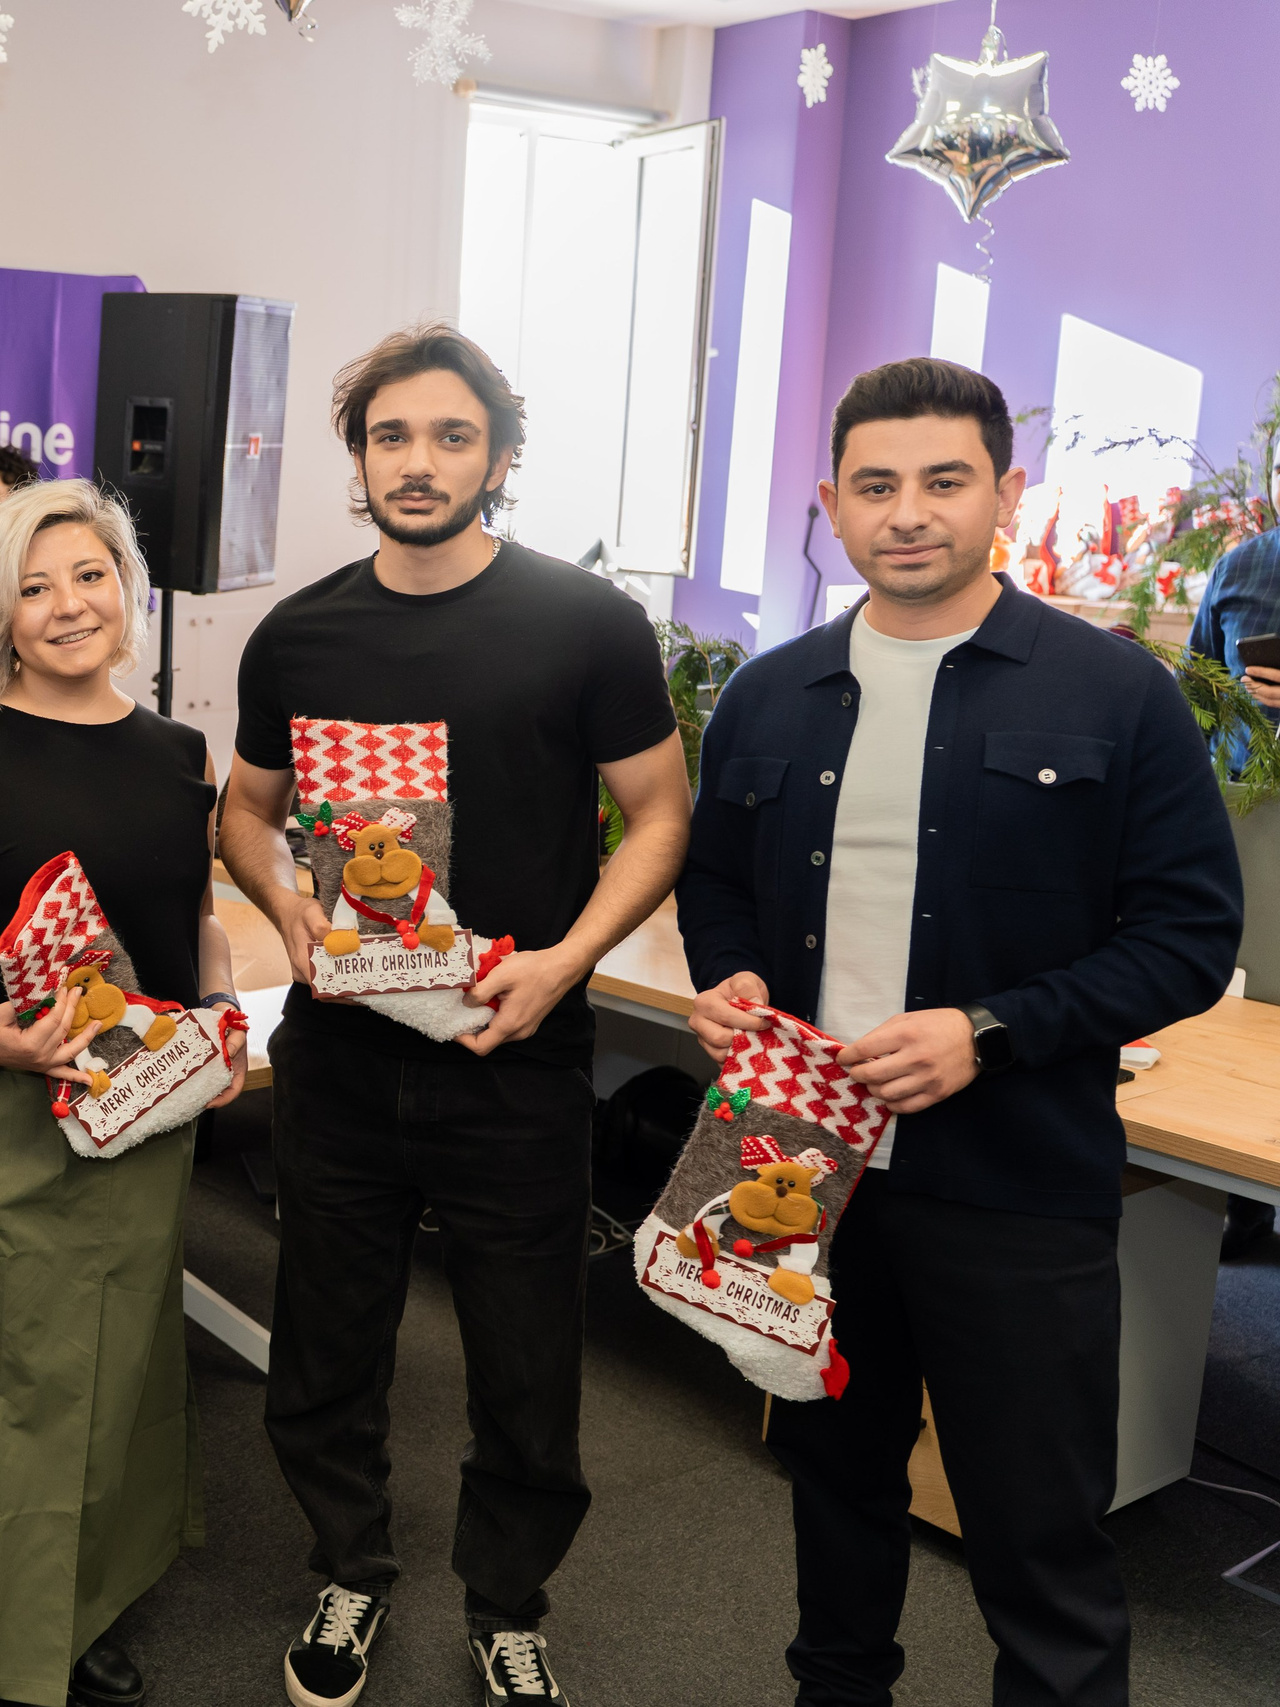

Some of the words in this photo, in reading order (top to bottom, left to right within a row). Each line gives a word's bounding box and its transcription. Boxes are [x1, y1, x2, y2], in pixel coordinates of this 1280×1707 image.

[334, 956, 374, 975] MERRY
[381, 951, 449, 972] CHRISTMAS
[99, 1082, 135, 1117] MERRY
[135, 1040, 190, 1089] CHRISTMAS
[675, 1260, 706, 1285] MER
[726, 1280, 801, 1324] CHRISTMAS
